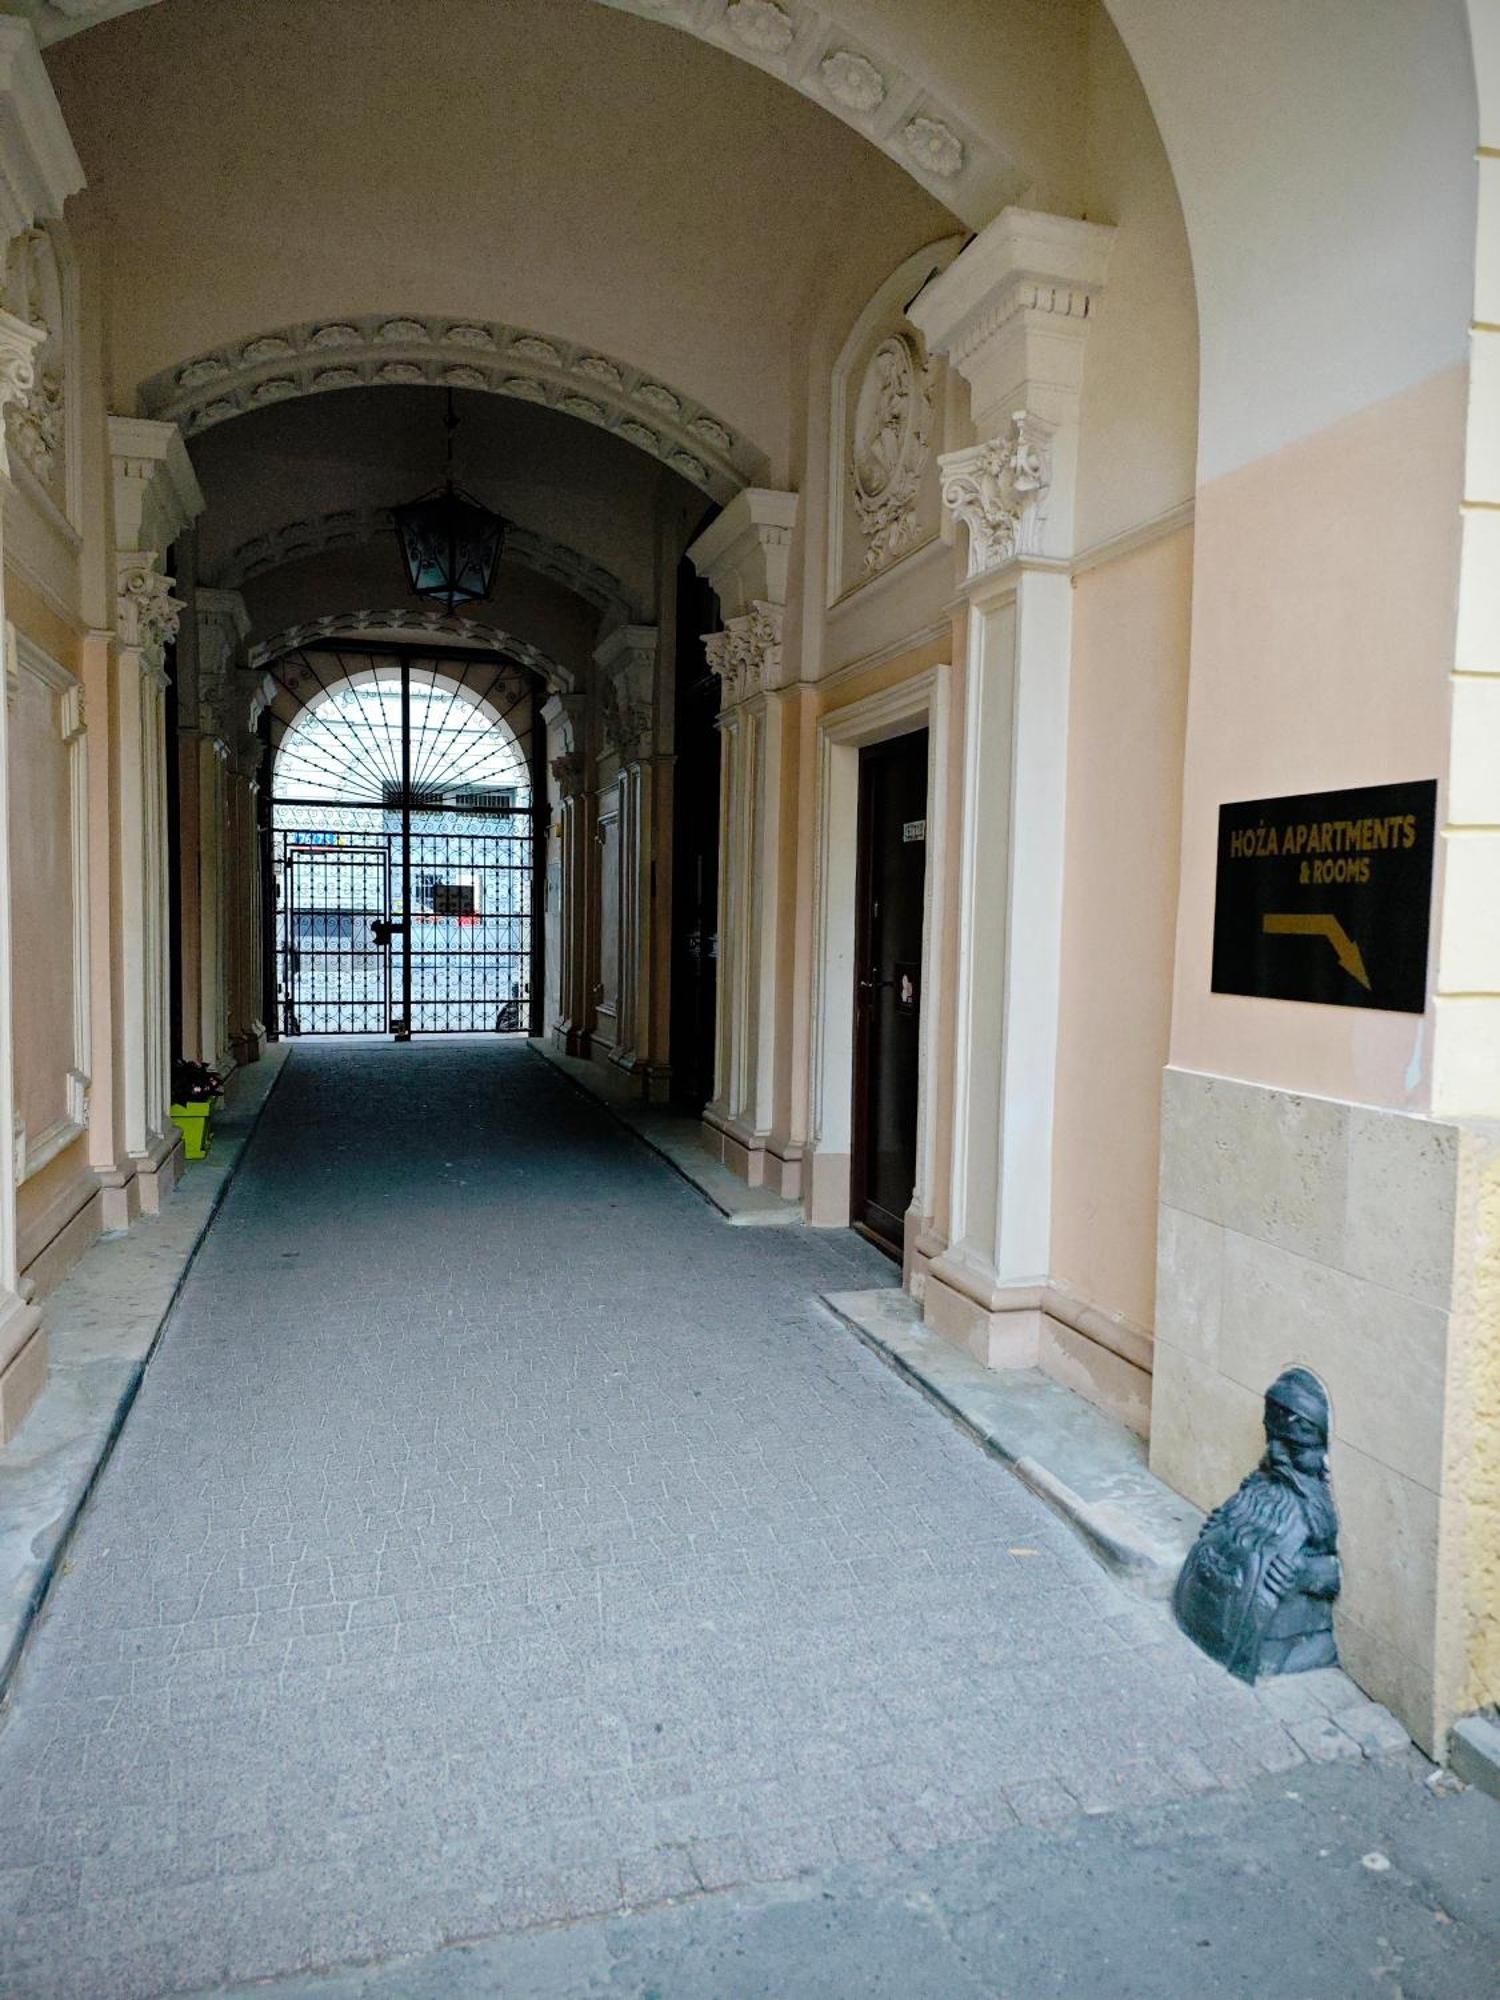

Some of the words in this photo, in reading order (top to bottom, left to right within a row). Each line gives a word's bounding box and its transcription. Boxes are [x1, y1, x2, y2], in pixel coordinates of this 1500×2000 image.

[1230, 819, 1279, 858] HOŻA
[1282, 814, 1416, 855] APARTMENTS
[1300, 860, 1311, 884] &
[1312, 857, 1371, 884] ROOMS
